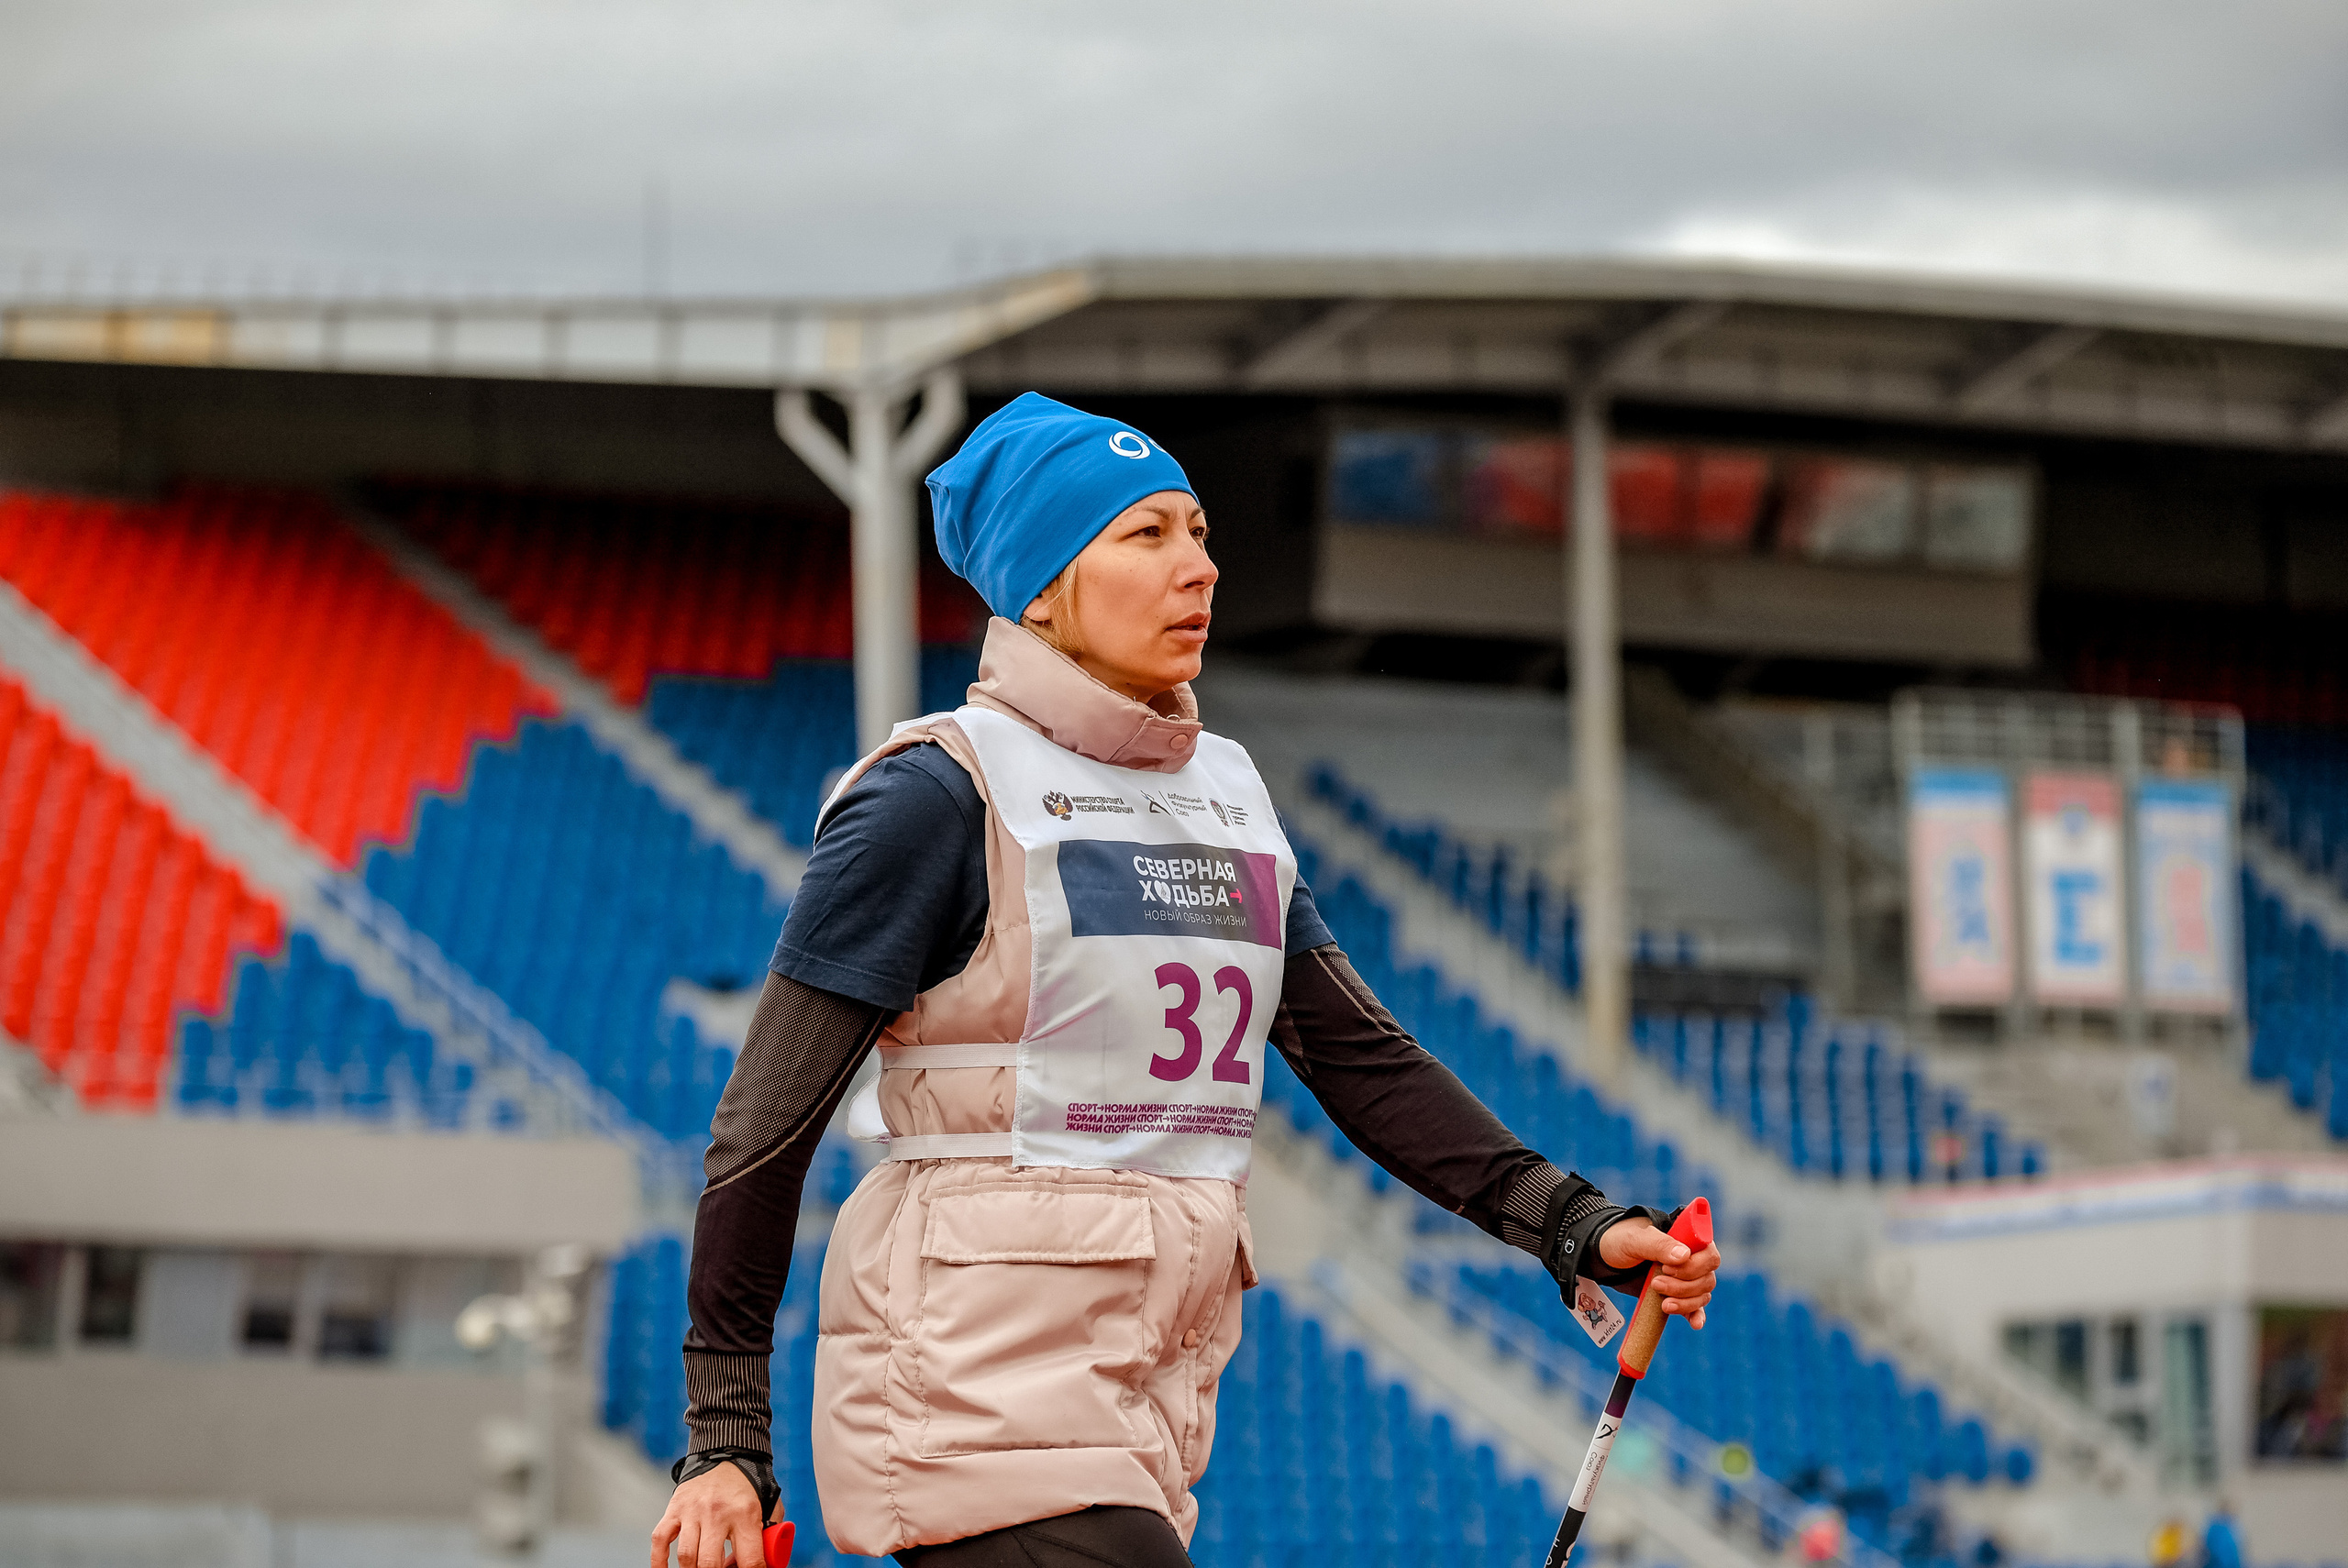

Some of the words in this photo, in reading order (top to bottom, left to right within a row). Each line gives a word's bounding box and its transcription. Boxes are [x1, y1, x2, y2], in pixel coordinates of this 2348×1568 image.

[1133, 855, 1237, 882] СЕВЕРНАЯ
[1144, 909, 1182, 922] НОВЫЙ
[1182, 911, 1213, 925] ОБРАЗ
[1213, 914, 1247, 927] ЖИЗНИ
[1148, 962, 1253, 1085] 32
[1066, 1113, 1103, 1123] НОРМА
[1104, 1114, 1136, 1123] ЖИЗНИ
[1195, 1115, 1217, 1124] ЖИЗНИ
[1138, 1104, 1168, 1113] ЖИЗНИ
[1219, 1107, 1237, 1117] ЖИЗНИ
[1065, 1122, 1102, 1132] ЖИЗНИ
[1171, 1124, 1193, 1134] ЖИЗНИ
[1586, 1452, 1598, 1472] Союз
[1581, 1454, 1605, 1506] Физкультурный
